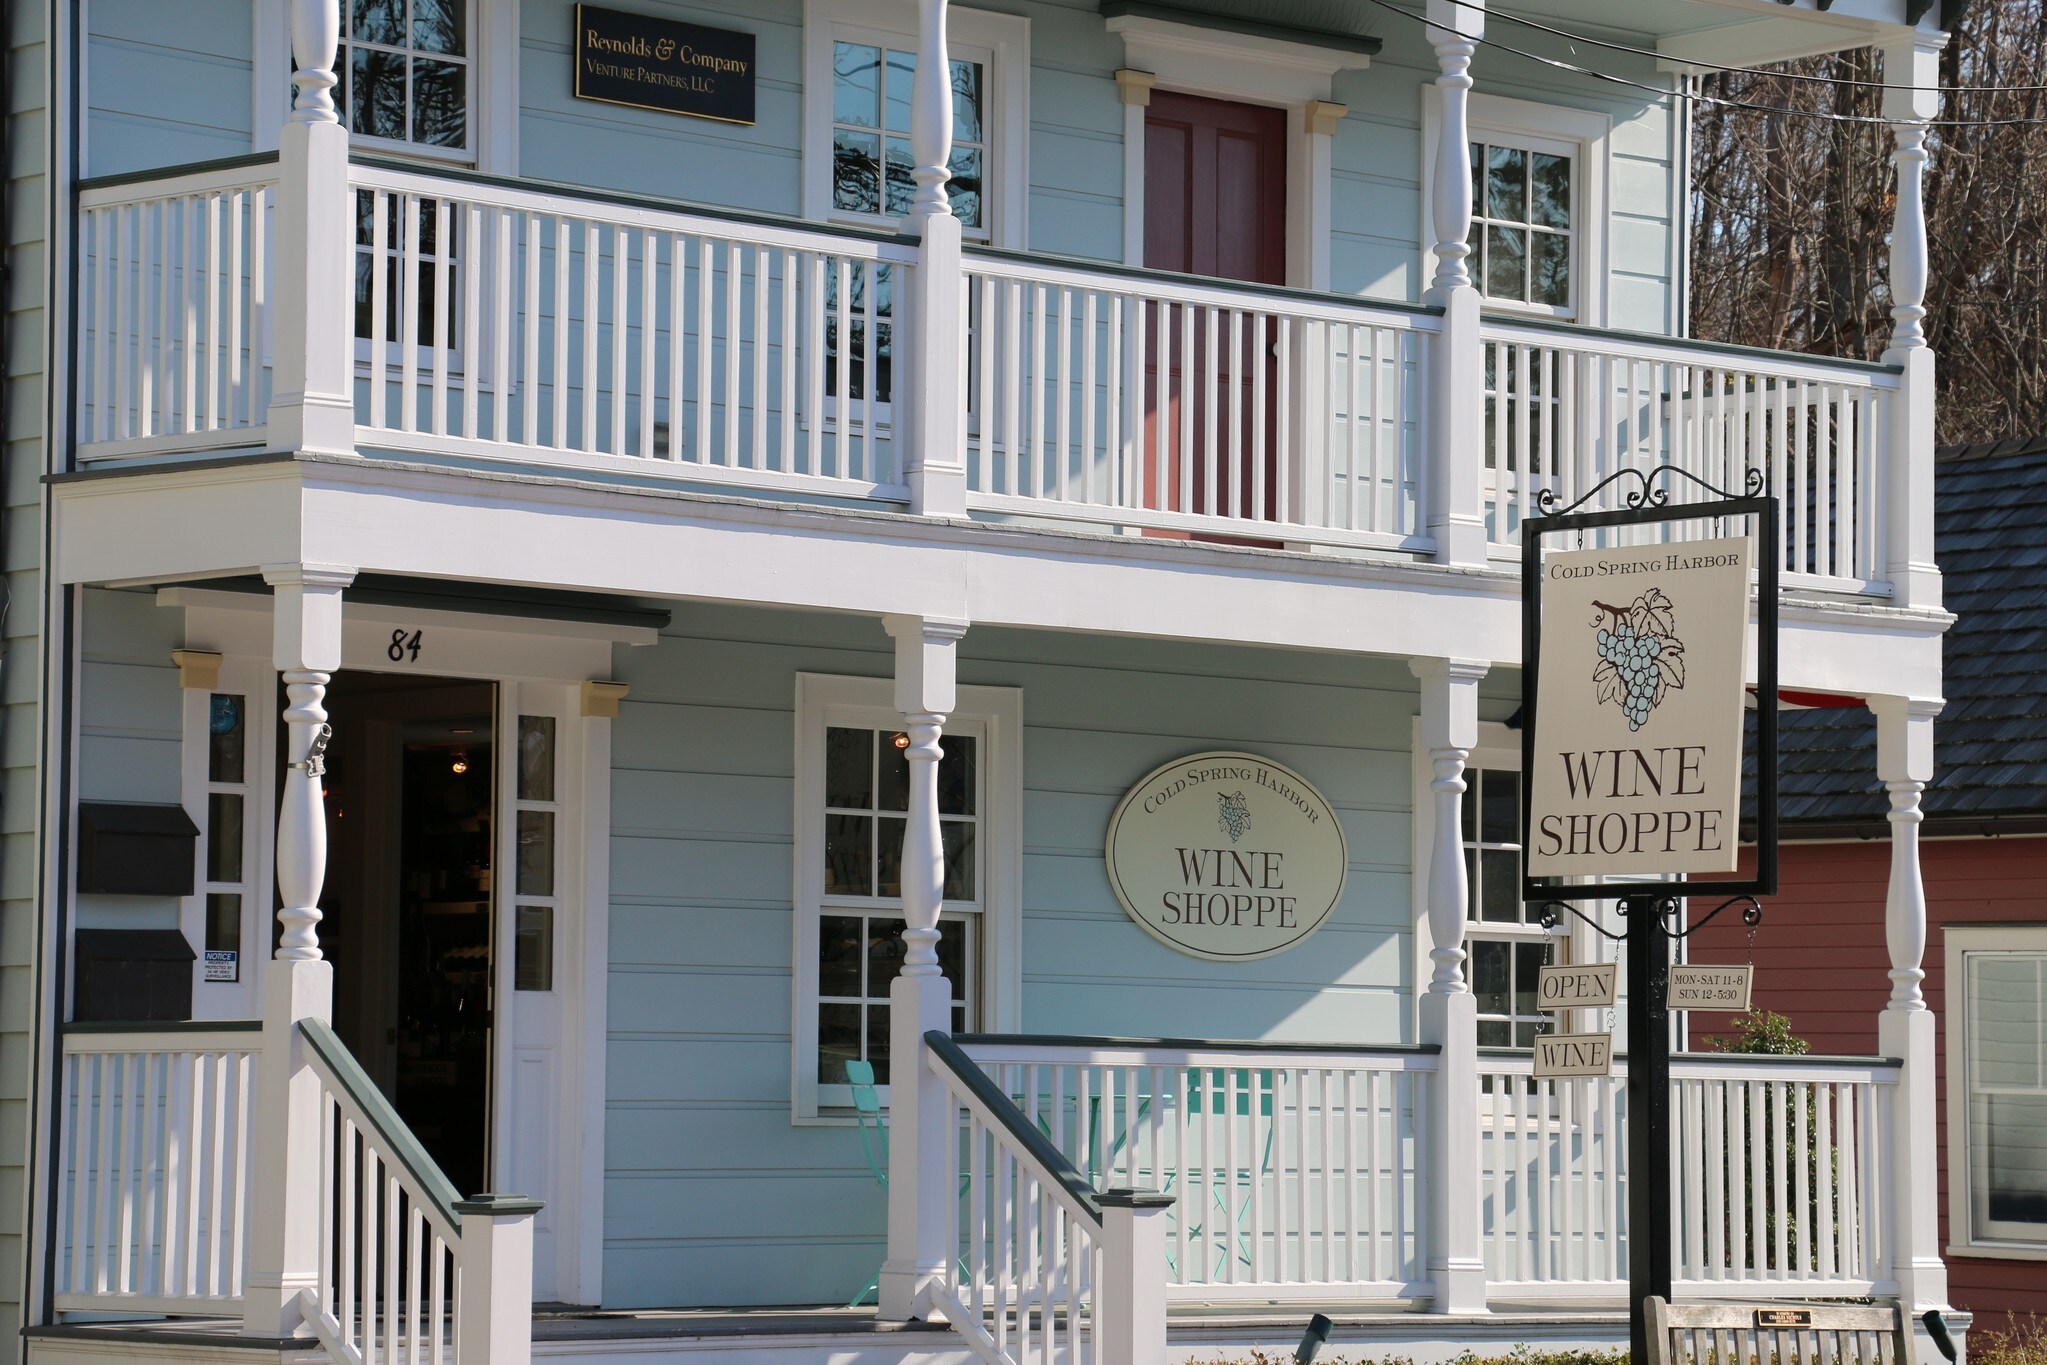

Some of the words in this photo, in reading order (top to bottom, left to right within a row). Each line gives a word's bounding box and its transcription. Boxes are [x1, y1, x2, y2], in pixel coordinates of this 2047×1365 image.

[586, 28, 651, 58] Reynolds
[655, 38, 676, 61] &
[680, 46, 748, 77] Company
[586, 58, 636, 81] VENTURE
[637, 66, 689, 90] PARTNERS,
[691, 76, 715, 94] LLC
[1550, 563, 1595, 580] COLD
[1597, 559, 1662, 577] SPRING
[1666, 553, 1740, 571] HARBOR
[388, 628, 423, 663] 84
[1558, 746, 1707, 800] WINE
[1143, 779, 1187, 815] COLD
[1187, 767, 1252, 787] SPRING
[1255, 767, 1320, 825] HARBOR
[1537, 809, 1723, 857] SHOPPE
[1174, 847, 1285, 890] WINE
[1161, 891, 1298, 928] SHOPPE
[206, 952, 232, 960] NOTICE
[1543, 973, 1611, 999] OPEN
[1674, 974, 1720, 985] MON-SAT
[1722, 975, 1743, 986] 11-8
[1678, 989, 1700, 999] SUN
[1701, 989, 1738, 1000] 12-5:30
[1541, 1042, 1605, 1068] WINE
